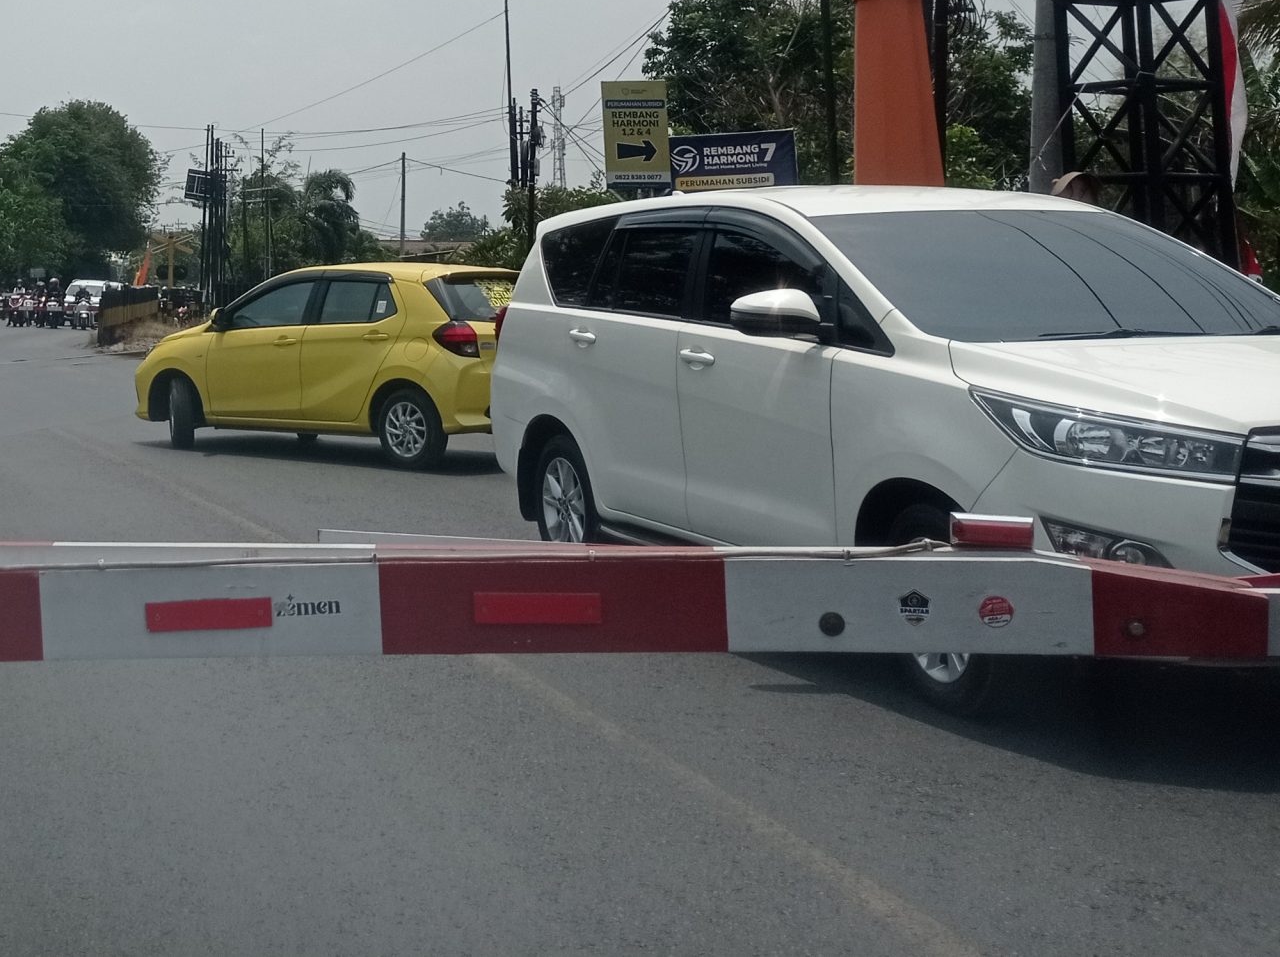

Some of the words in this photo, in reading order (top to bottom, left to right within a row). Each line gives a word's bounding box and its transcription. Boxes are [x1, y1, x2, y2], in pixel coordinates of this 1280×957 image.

[611, 111, 659, 119] REMBANG
[612, 119, 659, 128] HARMONI
[622, 128, 635, 136] 1,2
[636, 128, 643, 136] &
[645, 128, 651, 136] 4
[703, 144, 759, 155] REMBANG
[704, 154, 758, 164] HARMONI
[760, 143, 776, 162] 7
[680, 178, 735, 187] PERUMAHAN
[736, 176, 770, 185] SUBSIDI
